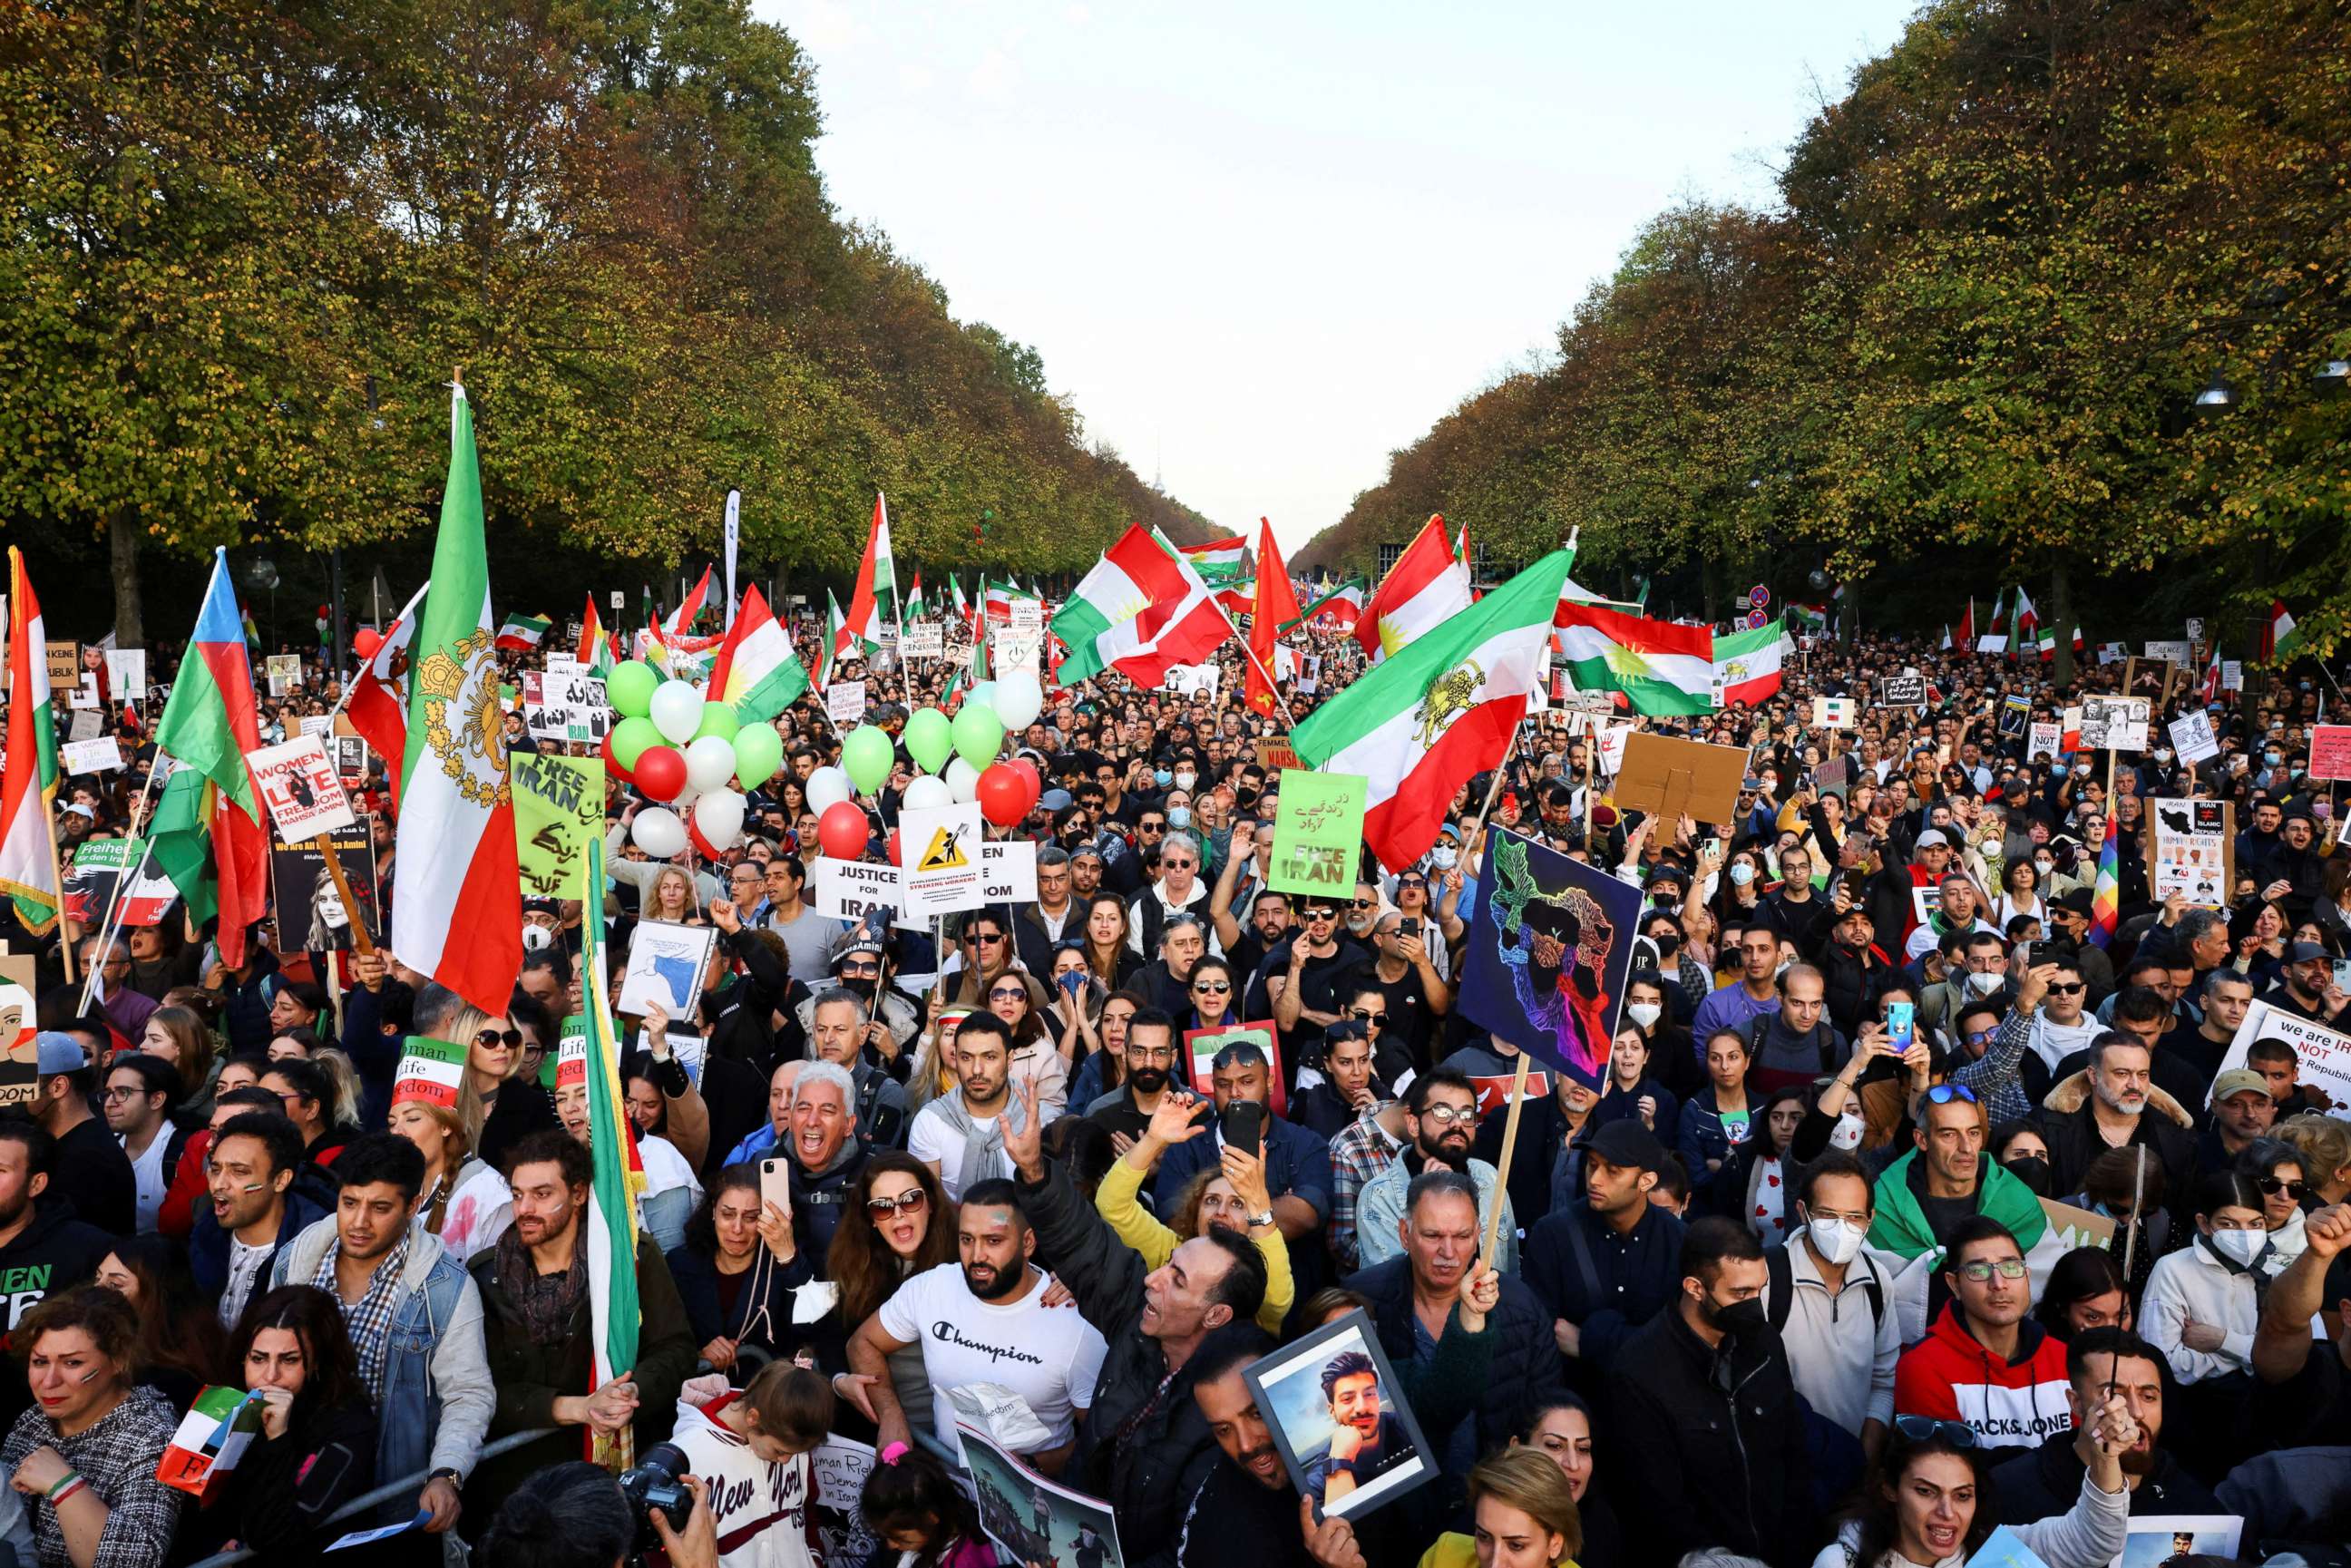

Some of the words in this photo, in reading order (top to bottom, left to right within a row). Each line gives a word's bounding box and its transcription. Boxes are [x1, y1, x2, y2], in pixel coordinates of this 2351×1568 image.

[51, 649, 75, 659] KEINE
[568, 725, 590, 740] IRAN
[2034, 736, 2057, 745] NOT
[256, 750, 325, 781] WOMEN
[1268, 751, 1297, 767] MAHSA
[533, 754, 588, 794] FREE
[513, 762, 580, 813] IRAN
[276, 790, 342, 820] FREEDOM
[280, 811, 315, 827] MAHSA
[318, 800, 345, 814] AMINI
[2195, 827, 2223, 836] REPUBLIC
[343, 839, 366, 850] Amini
[1294, 844, 1346, 864] FREE
[838, 866, 898, 884] JUSTICE
[1282, 859, 1344, 884] IRAN
[859, 885, 878, 895] FOR
[909, 881, 944, 890] STRIKING
[944, 876, 977, 885] WORKERS
[1635, 955, 1649, 969] JP
[2281, 1021, 2303, 1036] we
[2306, 1030, 2331, 1047] are
[2297, 1041, 2331, 1060] NOT
[932, 1320, 1043, 1364] Champion
[706, 1473, 755, 1524] New
[825, 1488, 835, 1498] in
[836, 1491, 858, 1503] Iran
